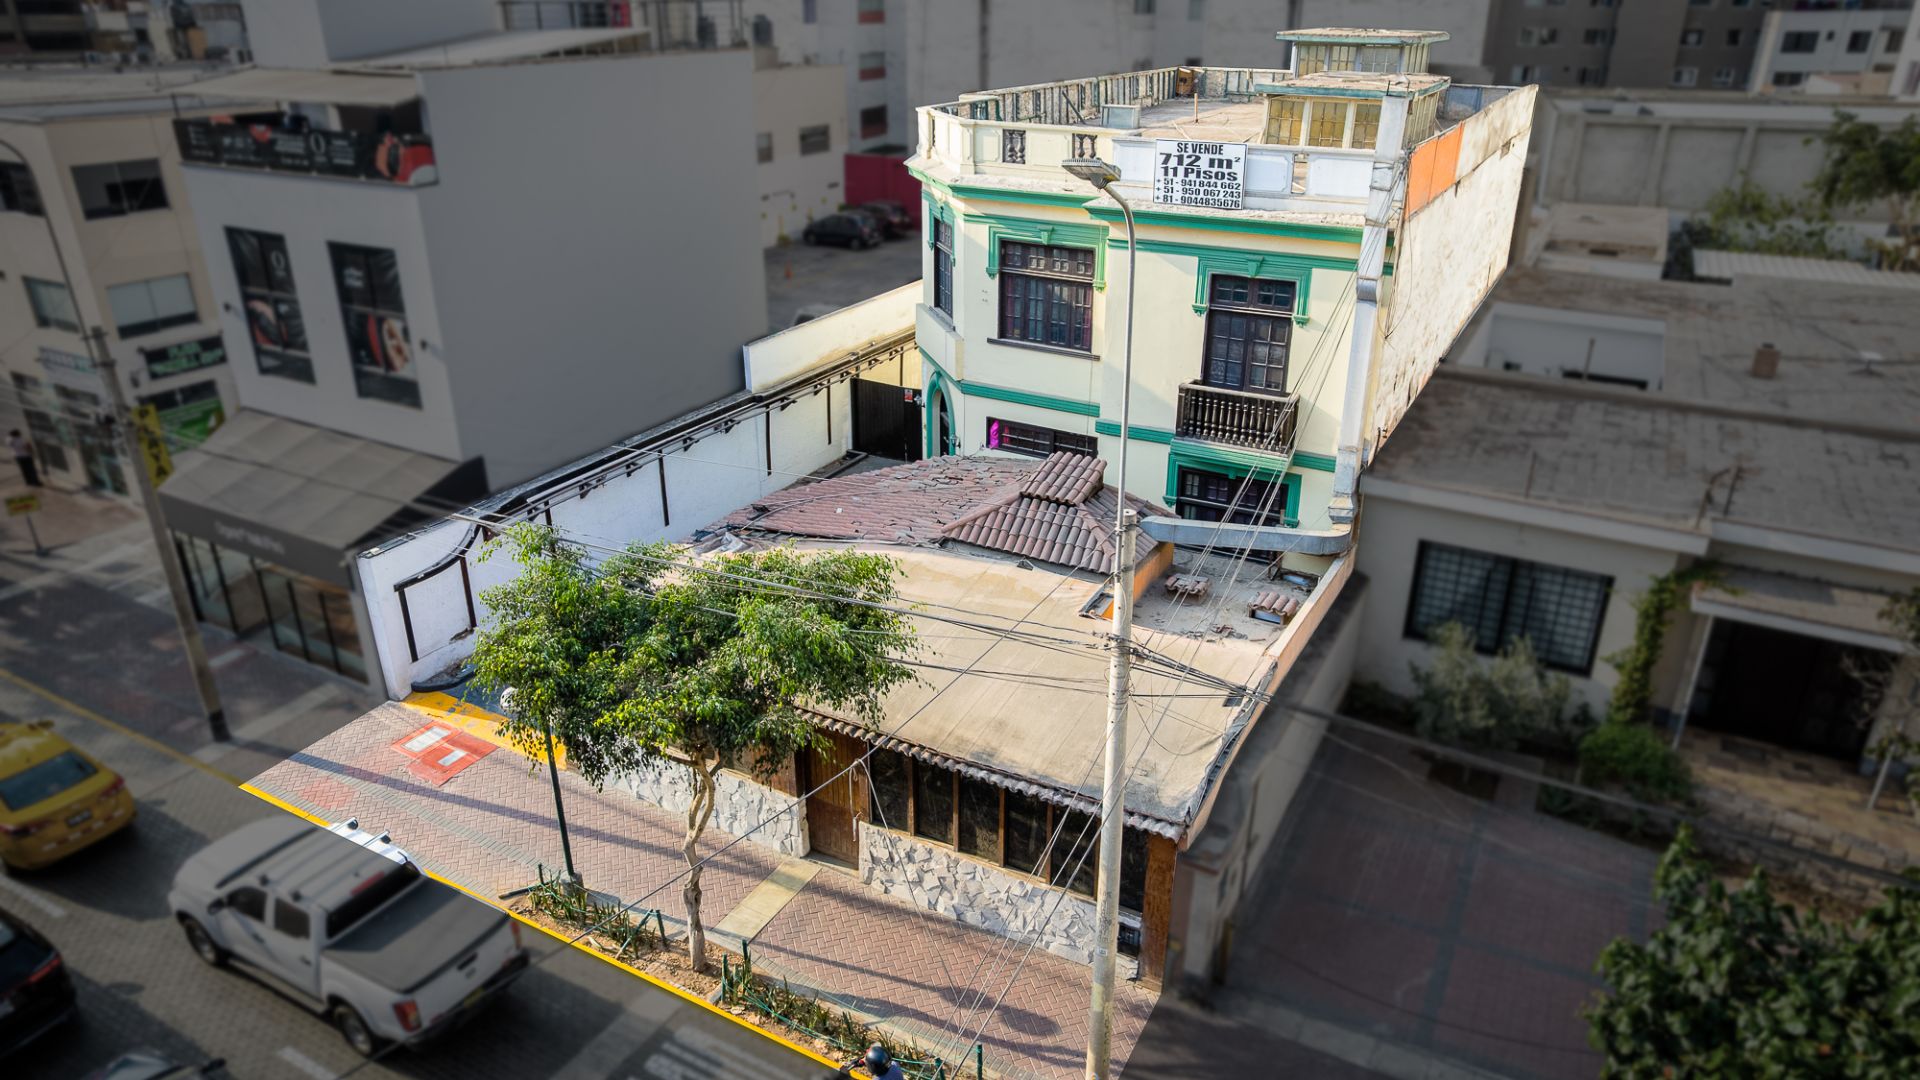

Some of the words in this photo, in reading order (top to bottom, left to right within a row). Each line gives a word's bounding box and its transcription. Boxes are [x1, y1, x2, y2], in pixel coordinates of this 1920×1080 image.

[1177, 142, 1189, 153] SE
[1191, 143, 1224, 155] VENDE
[1160, 152, 1201, 168] 712
[1160, 166, 1178, 178] 11
[1184, 168, 1238, 182] Pisos
[1181, 179, 1197, 187] 941
[1220, 182, 1241, 190] 662
[1182, 187, 1200, 196] 950
[1203, 189, 1220, 197] 067
[1222, 190, 1241, 199] 243
[1163, 194, 1173, 203] 81
[1181, 196, 1240, 208] 9044835676
